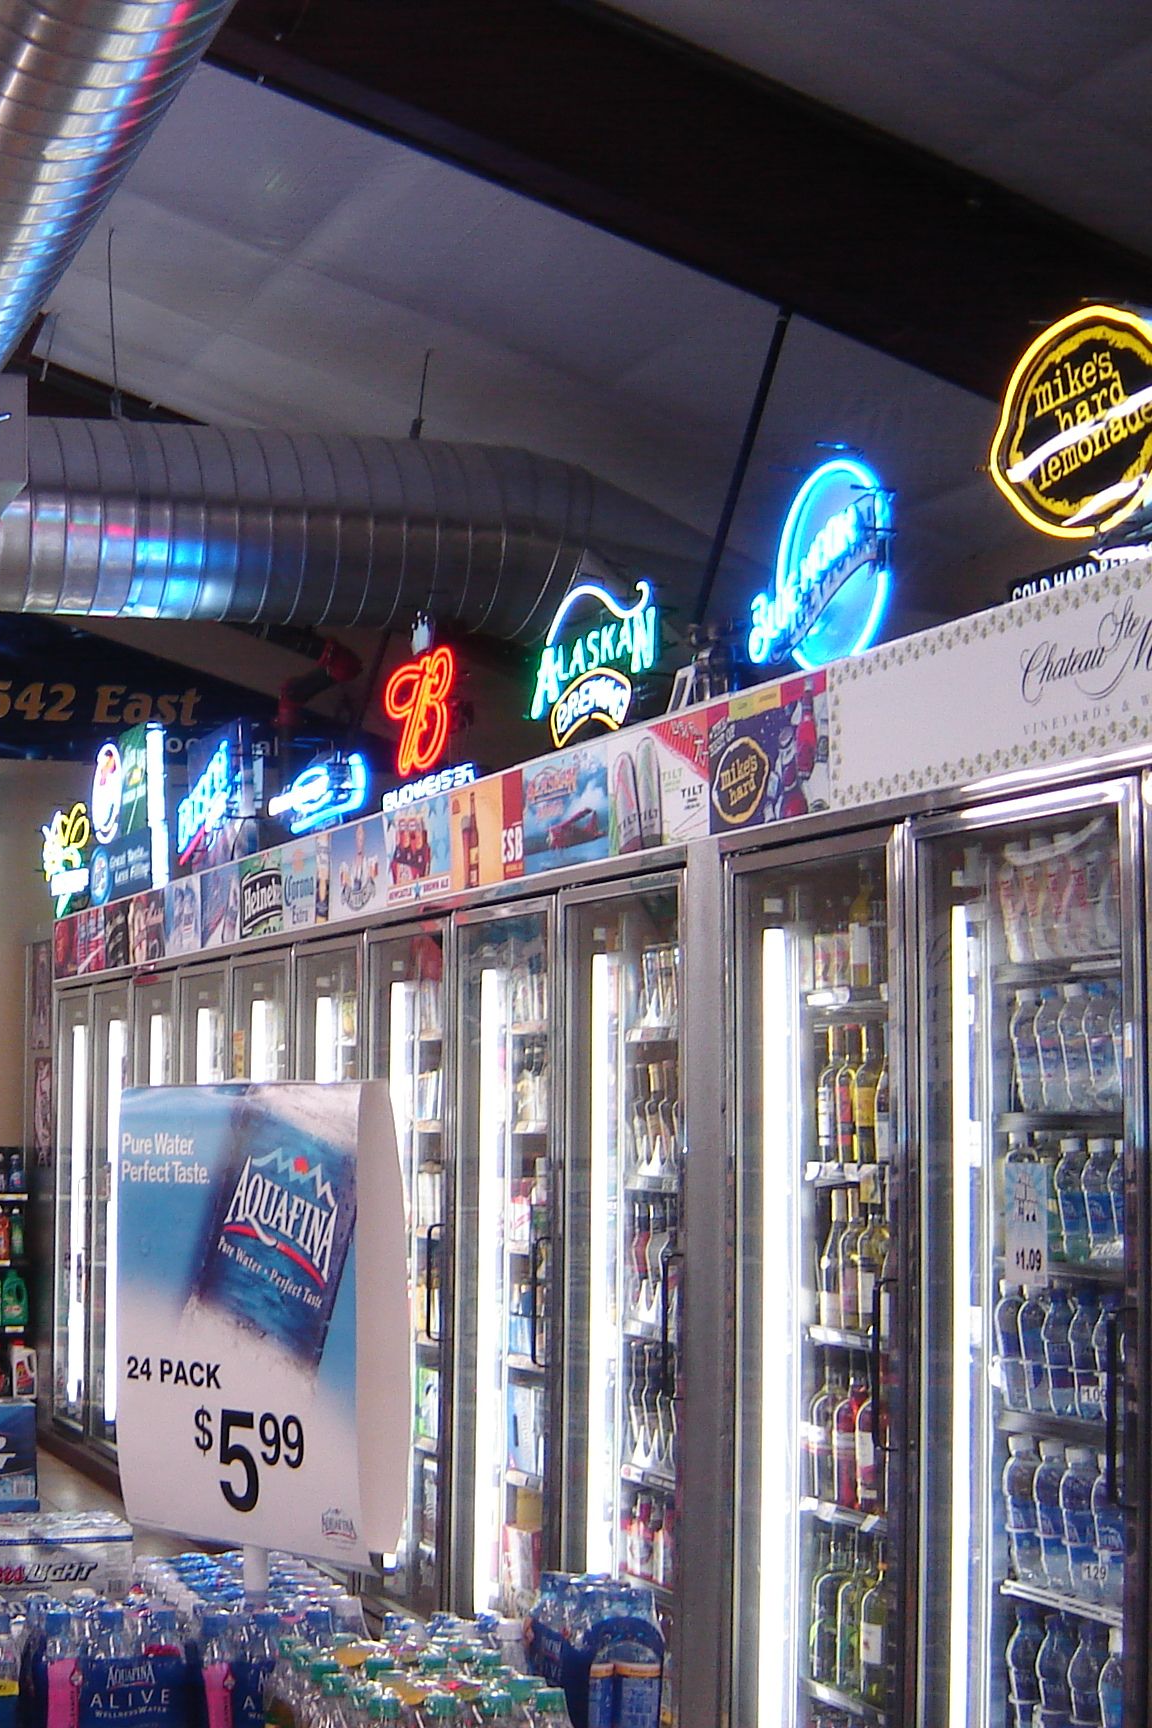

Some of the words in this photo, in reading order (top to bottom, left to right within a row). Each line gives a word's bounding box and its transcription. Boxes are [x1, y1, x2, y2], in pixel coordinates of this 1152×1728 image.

[1031, 350, 1114, 417] mike's
[530, 606, 657, 720] ALASKAN
[1020, 640, 1107, 706] Chateau
[92, 684, 202, 726] East
[720, 754, 758, 790] mike's
[681, 784, 703, 798] TILT
[729, 777, 757, 807] hard
[502, 825, 523, 864] ESB
[121, 1132, 151, 1155] Pure
[121, 1160, 170, 1183] Perfect
[171, 1161, 211, 1184] Taste.
[224, 1155, 339, 1284] AQUAFINA
[235, 1246, 263, 1275] Water
[269, 1267, 303, 1298] Perfect
[1016, 1249, 1042, 1273] $1.09
[127, 1355, 152, 1382] 24
[159, 1358, 221, 1389] PACK
[25, 1562, 98, 1583] LIGHT
[106, 1663, 156, 1690] AQUAFINA
[90, 1688, 171, 1710] ALIVE
